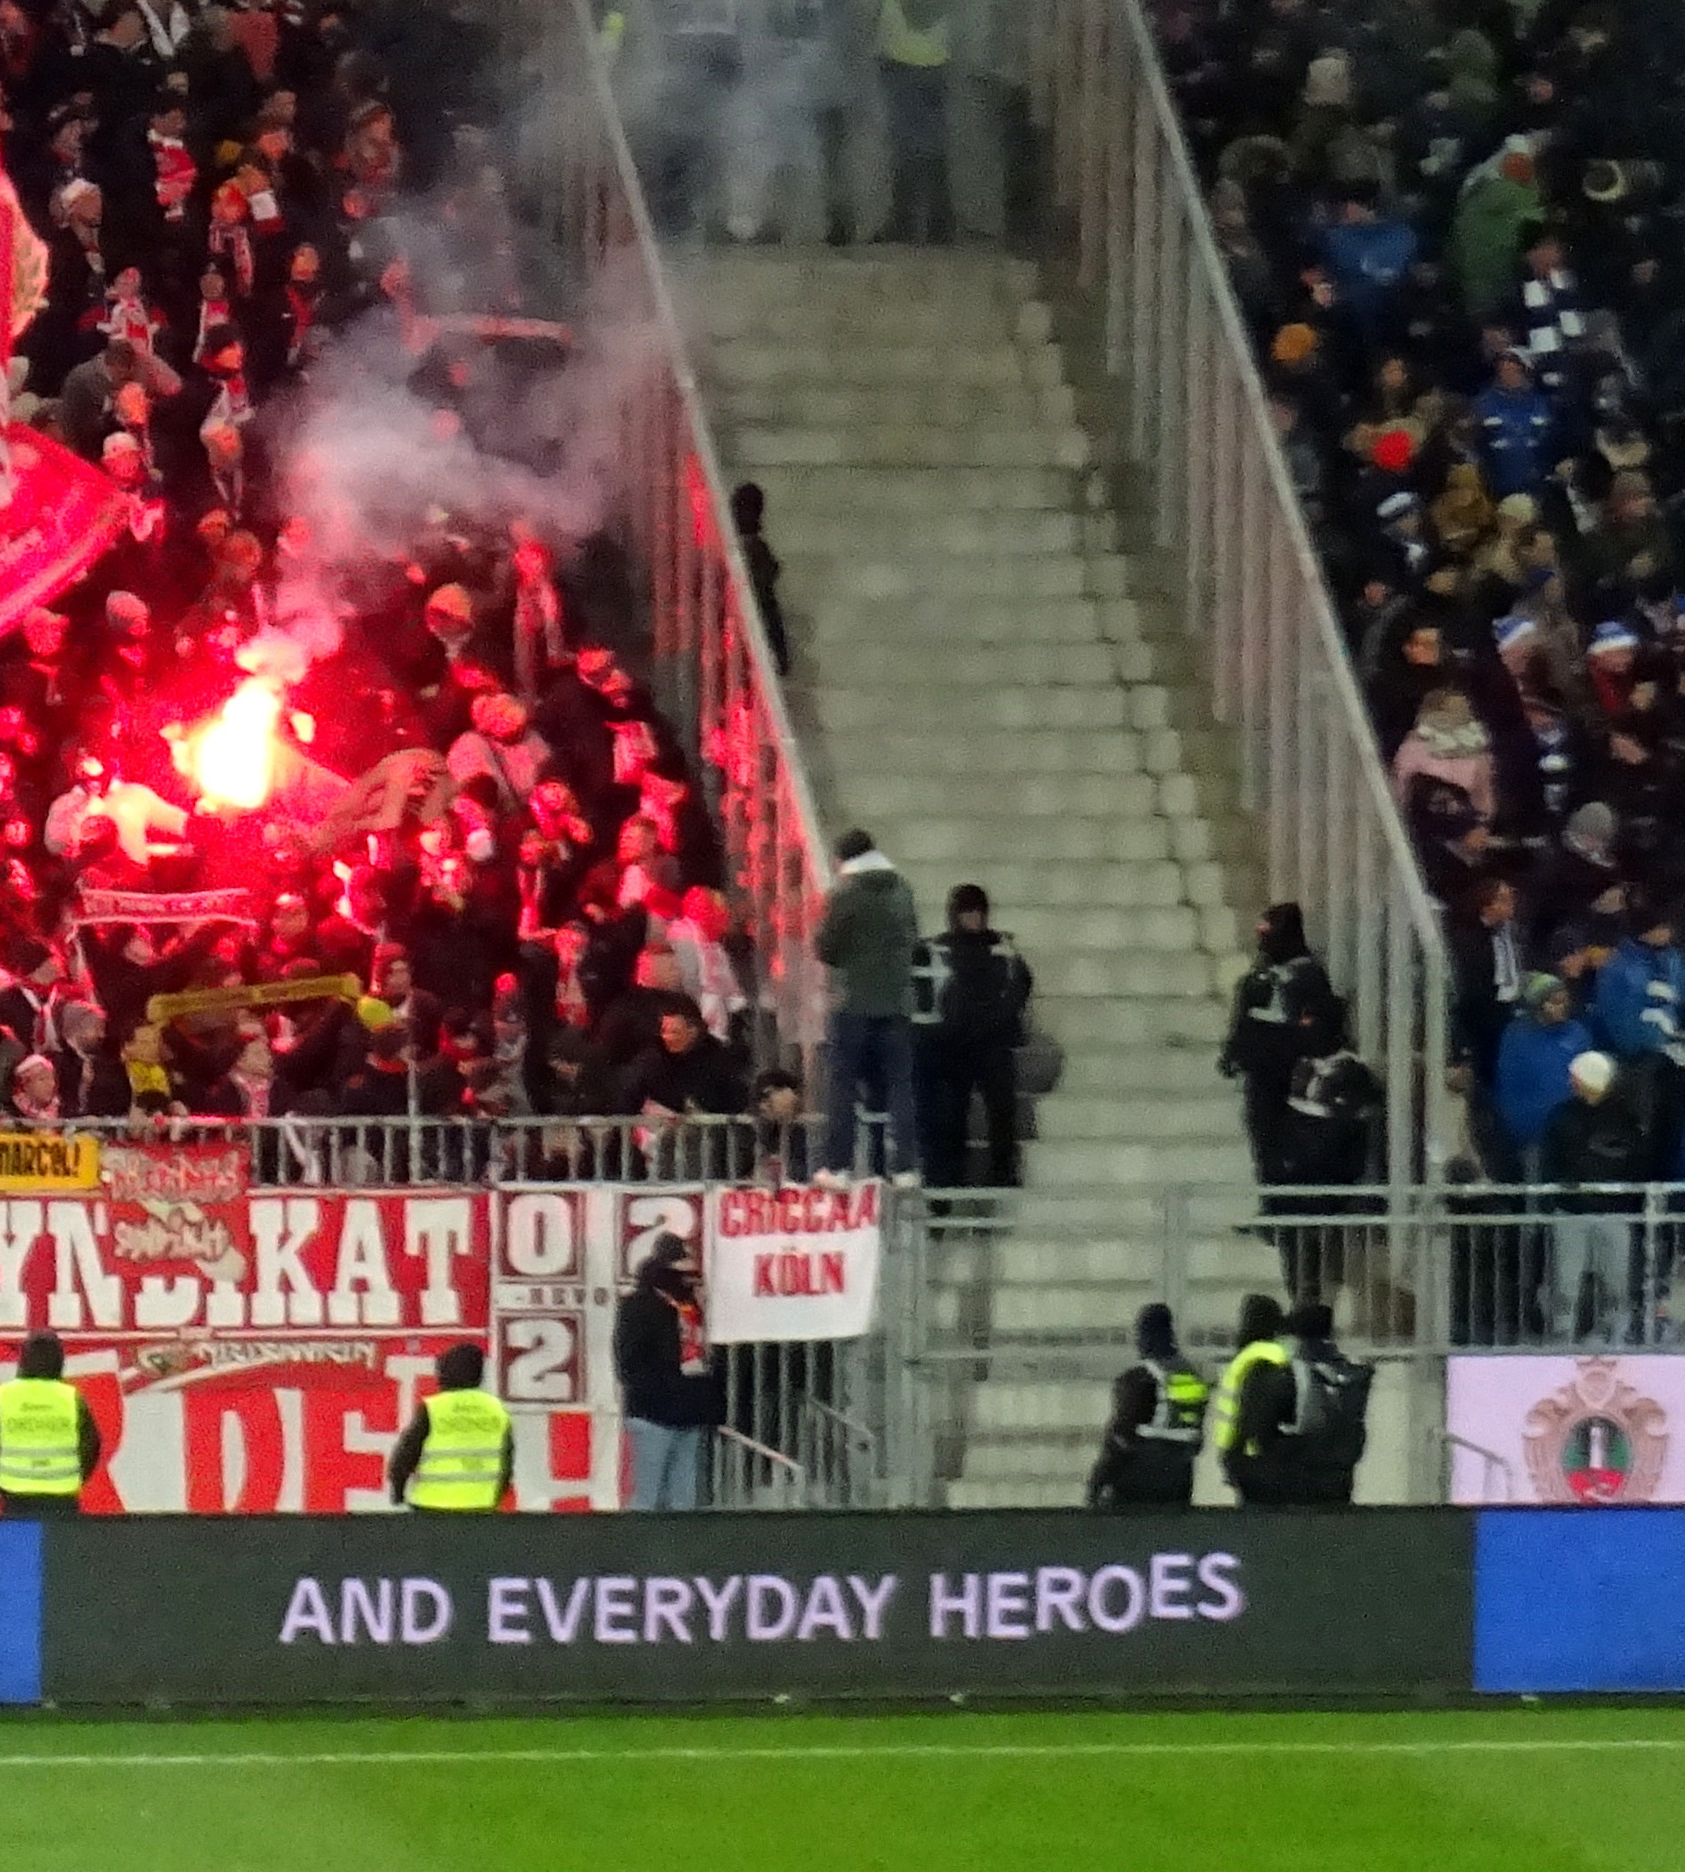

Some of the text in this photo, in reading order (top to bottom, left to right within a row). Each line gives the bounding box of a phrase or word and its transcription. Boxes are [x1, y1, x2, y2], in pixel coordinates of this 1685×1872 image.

[753, 1246, 845, 1297] KÖLN
[507, 1318, 576, 1402] 2
[279, 1551, 1246, 1645] AND EVERYDAY HEROES
